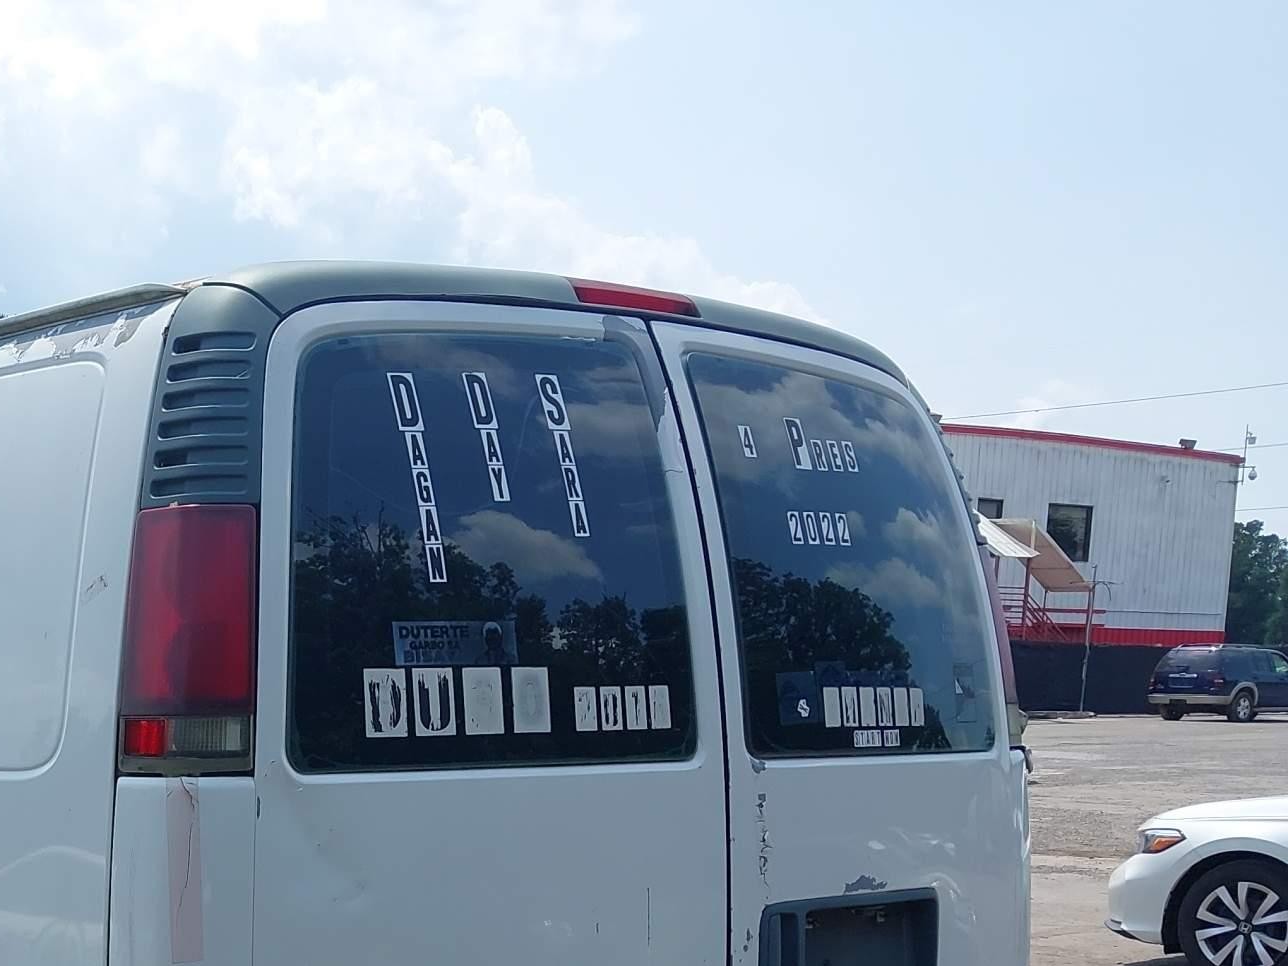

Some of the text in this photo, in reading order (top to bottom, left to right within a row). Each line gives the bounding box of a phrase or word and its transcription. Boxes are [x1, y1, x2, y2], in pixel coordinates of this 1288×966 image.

[740, 426, 756, 457] 4
[788, 512, 851, 545] 2022
[398, 625, 470, 640] DUTERTE
